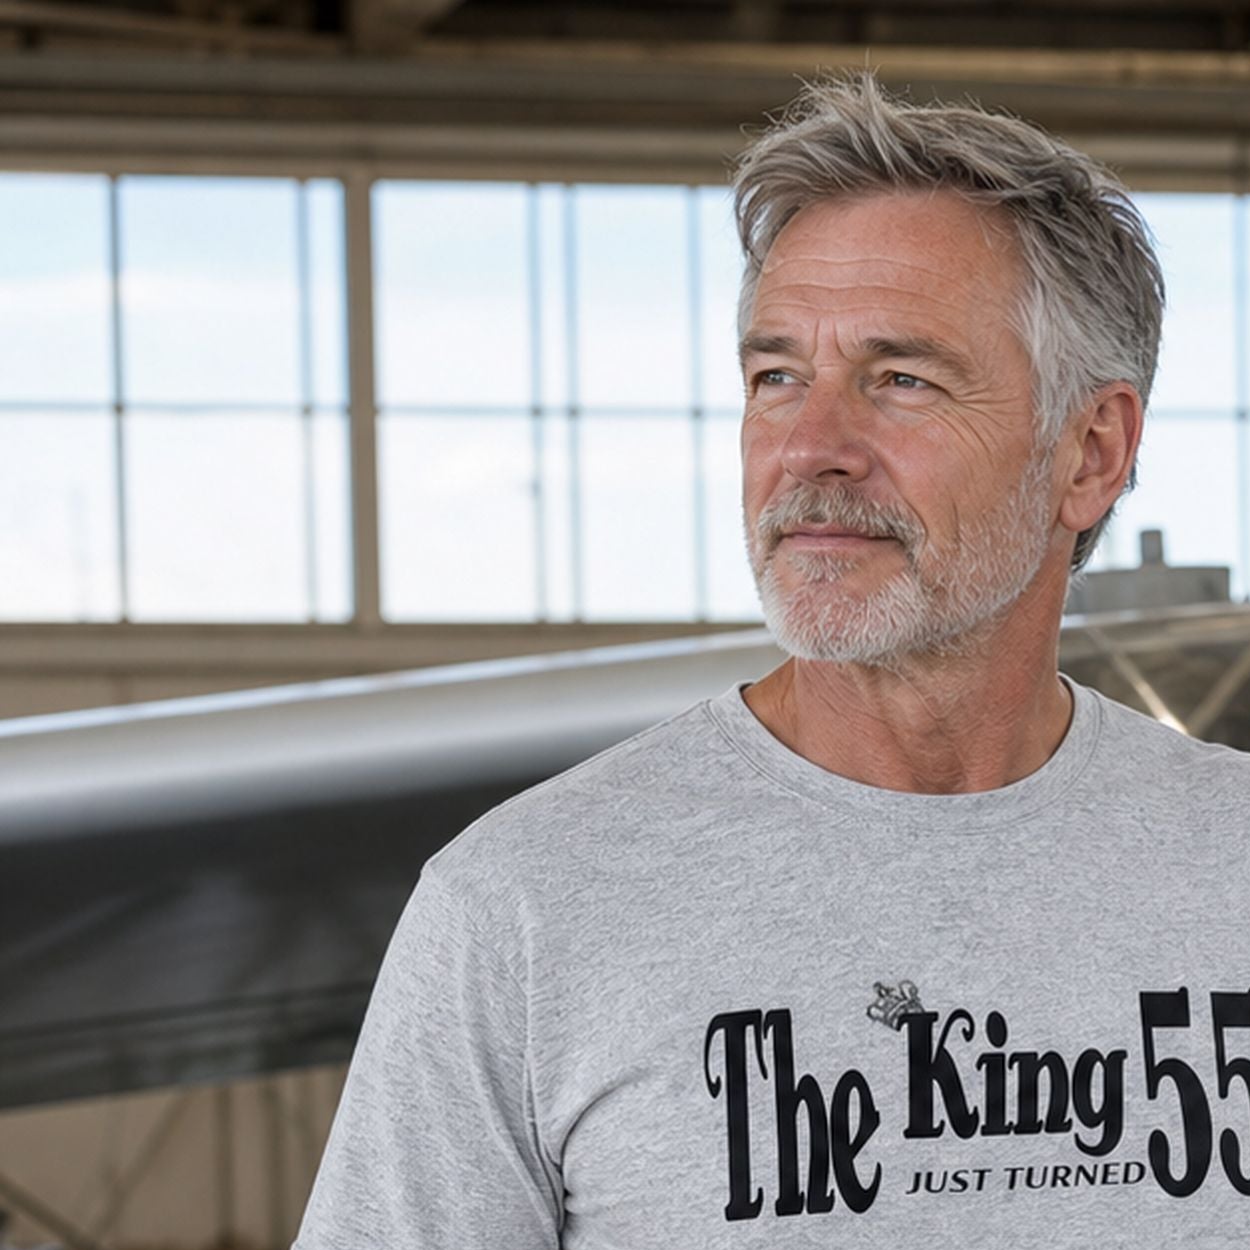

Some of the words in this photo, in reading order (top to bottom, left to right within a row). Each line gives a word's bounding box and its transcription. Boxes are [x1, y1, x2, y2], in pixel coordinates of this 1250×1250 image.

[703, 1007, 883, 1222] The
[901, 1008, 1128, 1157] King
[905, 1169, 992, 1195] JUST
[1004, 1161, 1147, 1191] TURNED
